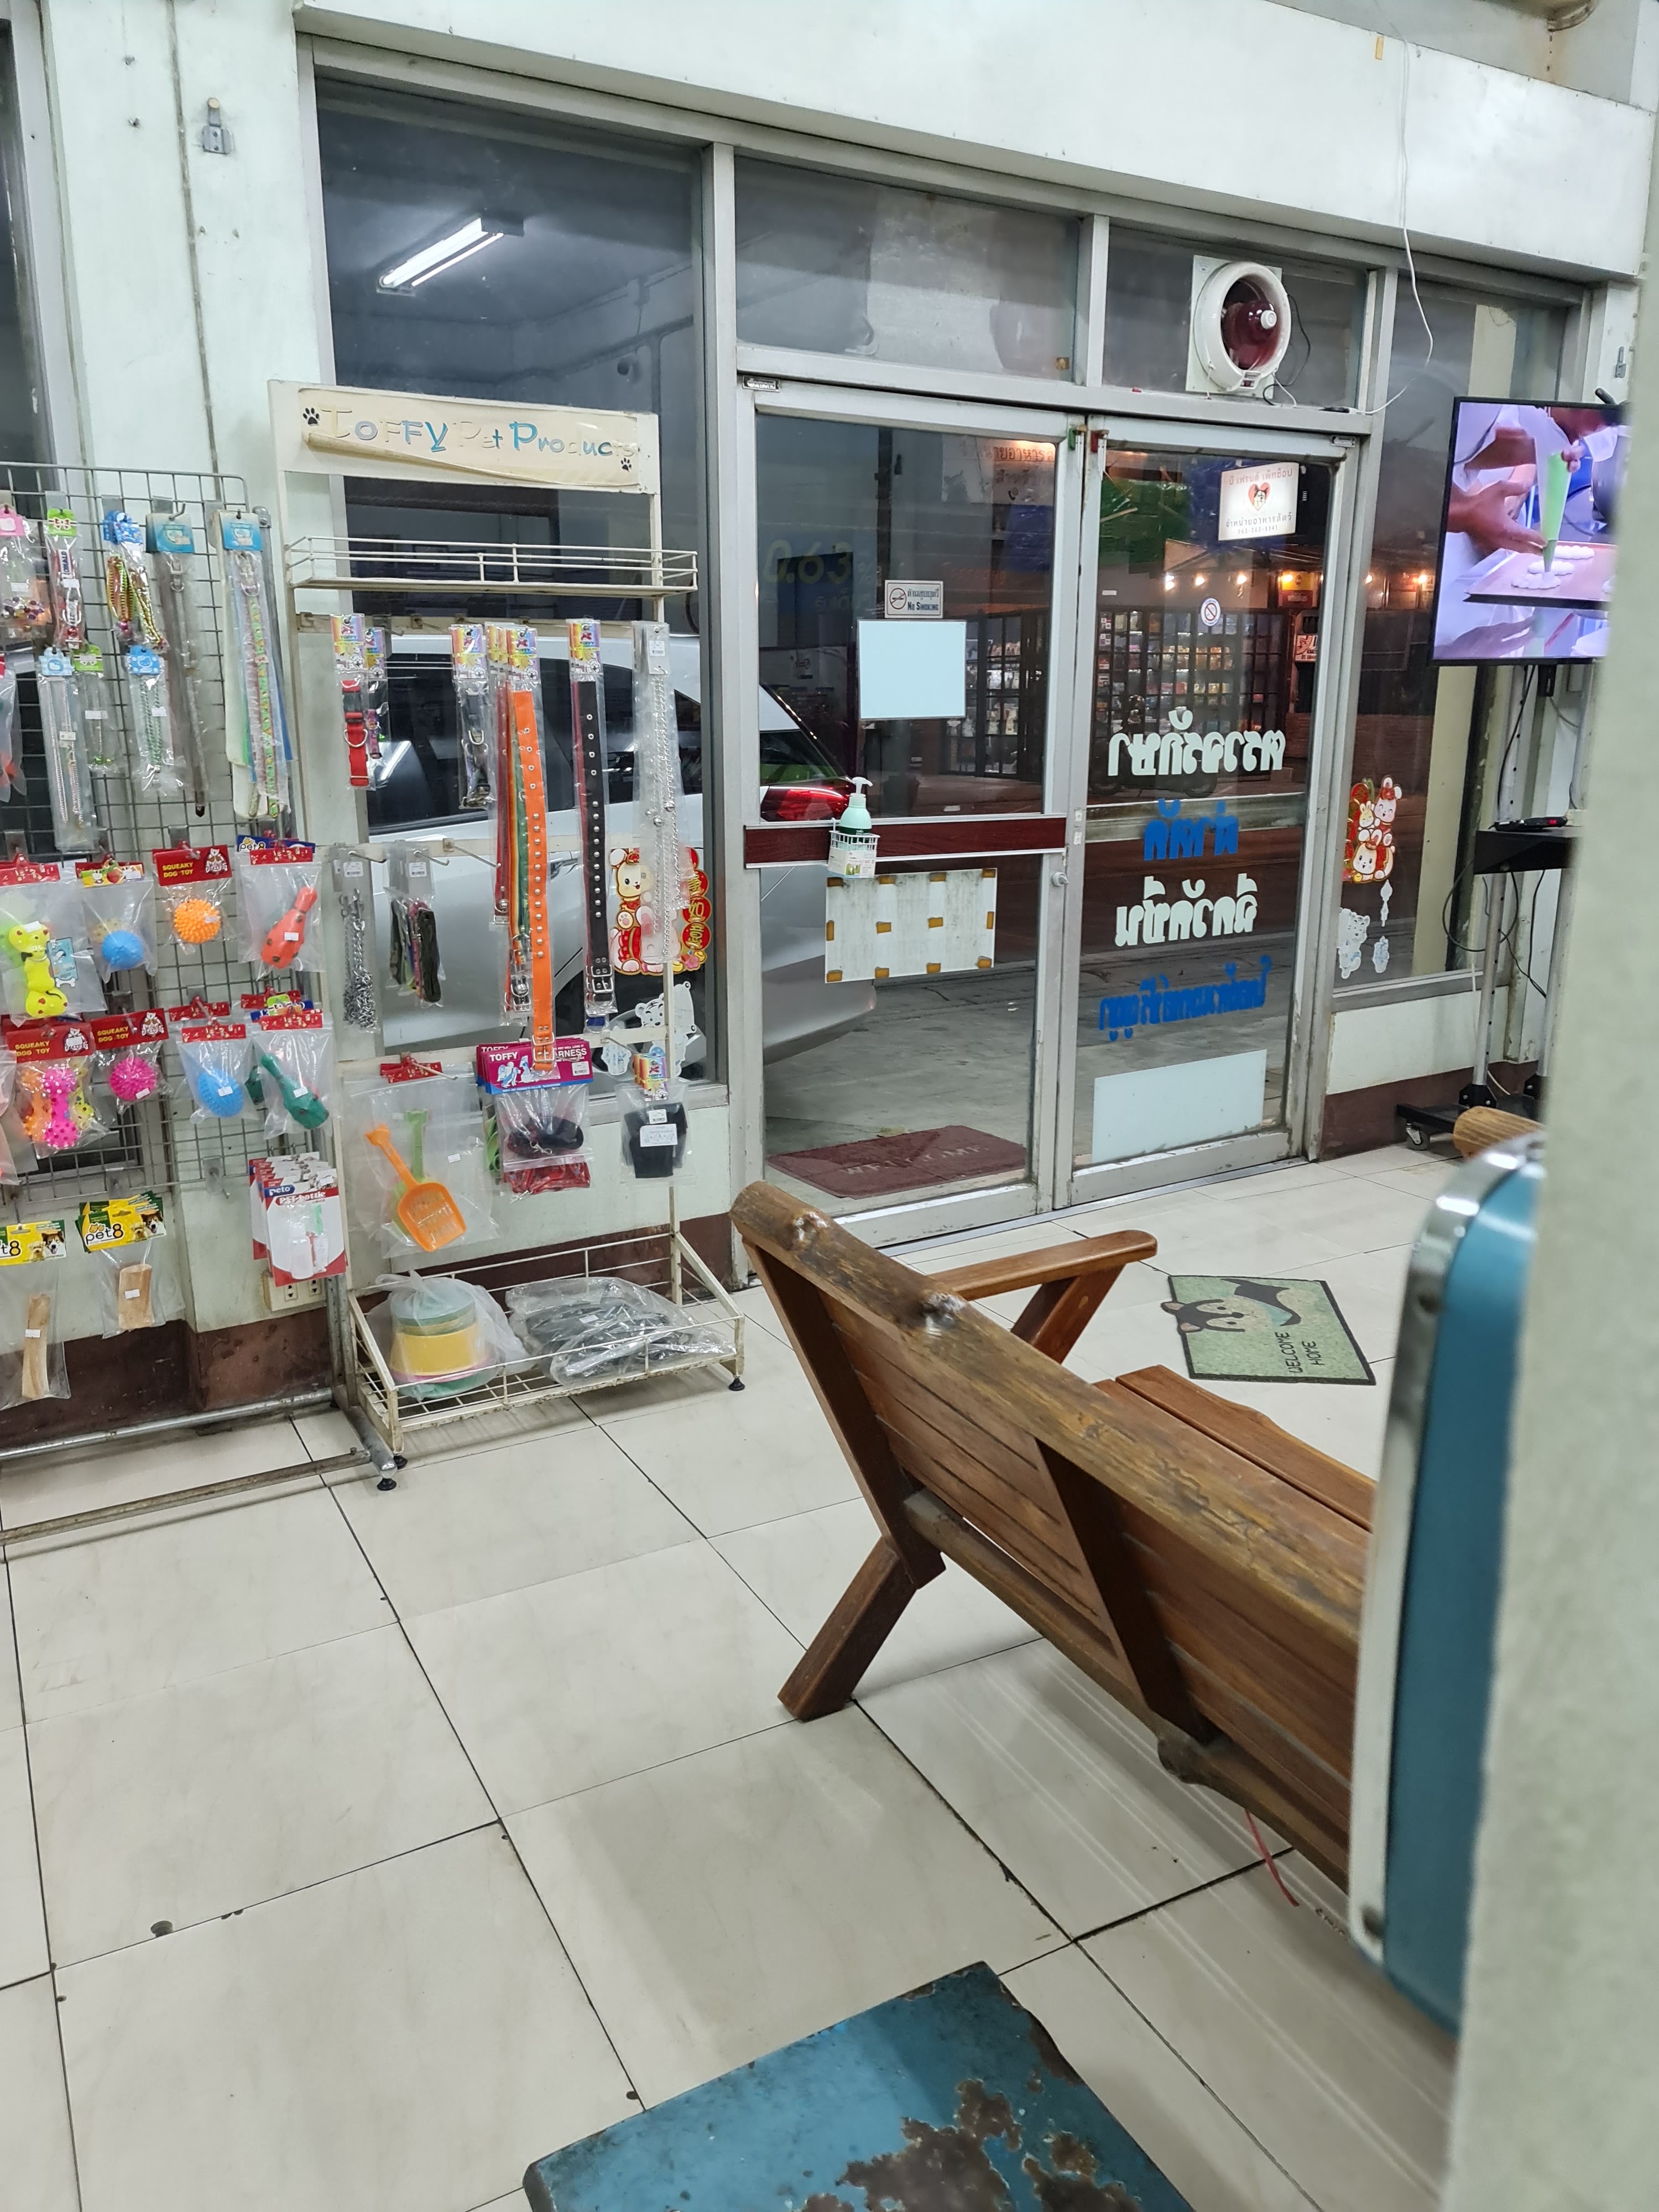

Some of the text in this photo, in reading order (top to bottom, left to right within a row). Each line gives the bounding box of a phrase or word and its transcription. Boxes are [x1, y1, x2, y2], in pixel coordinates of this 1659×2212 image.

[162, 862, 194, 871] SQUEAKY
[97, 1026, 129, 1036] SQUEAKY
[15, 1041, 50, 1050] SQUEAKY
[489, 1051, 518, 1062] TOFFY
[555, 1048, 587, 1057] RNESS
[85, 1223, 124, 1245] pet8
[1275, 1332, 1304, 1373] WELCOME
[1302, 1340, 1325, 1366] HOME
